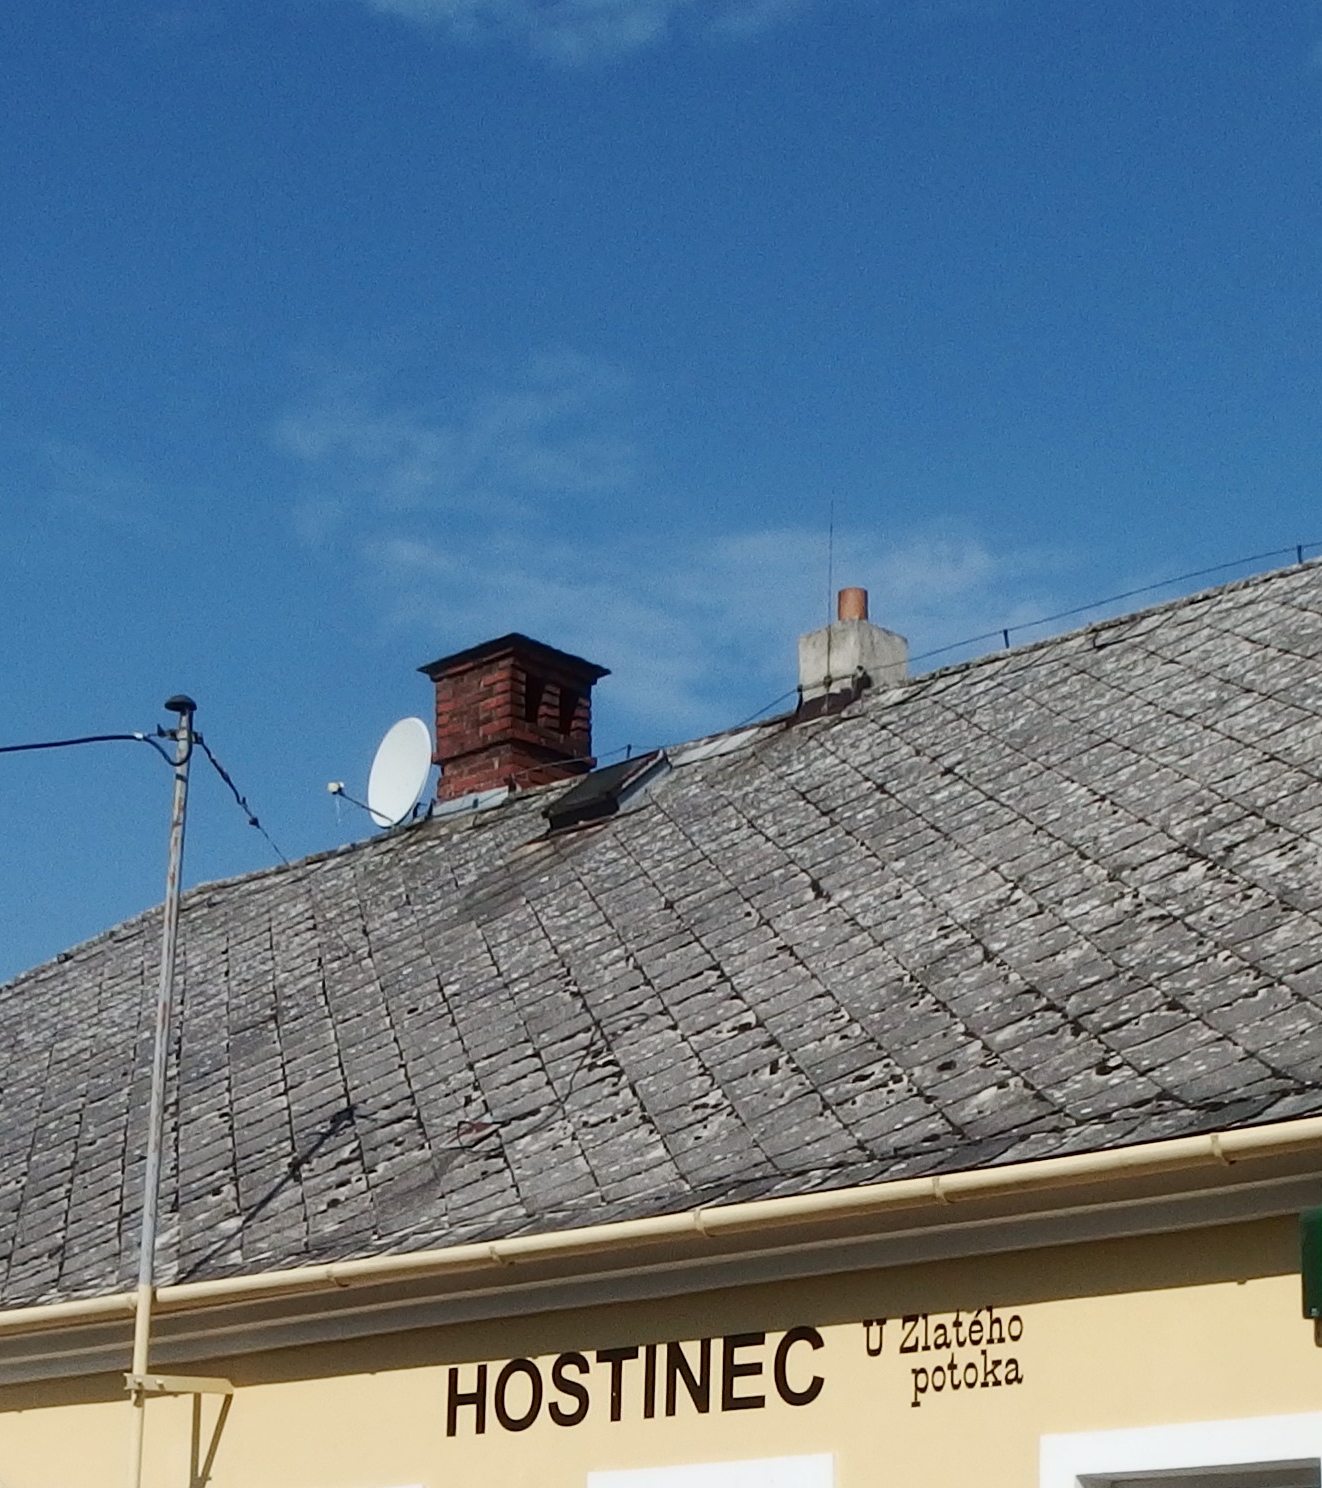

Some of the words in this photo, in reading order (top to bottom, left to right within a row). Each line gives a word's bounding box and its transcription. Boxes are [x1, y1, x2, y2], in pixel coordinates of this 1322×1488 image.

[862, 1317, 887, 1357] U
[899, 1305, 1023, 1354] Zlatého
[446, 1326, 825, 1437] HOSTINEC
[911, 1349, 1024, 1408] potoka
